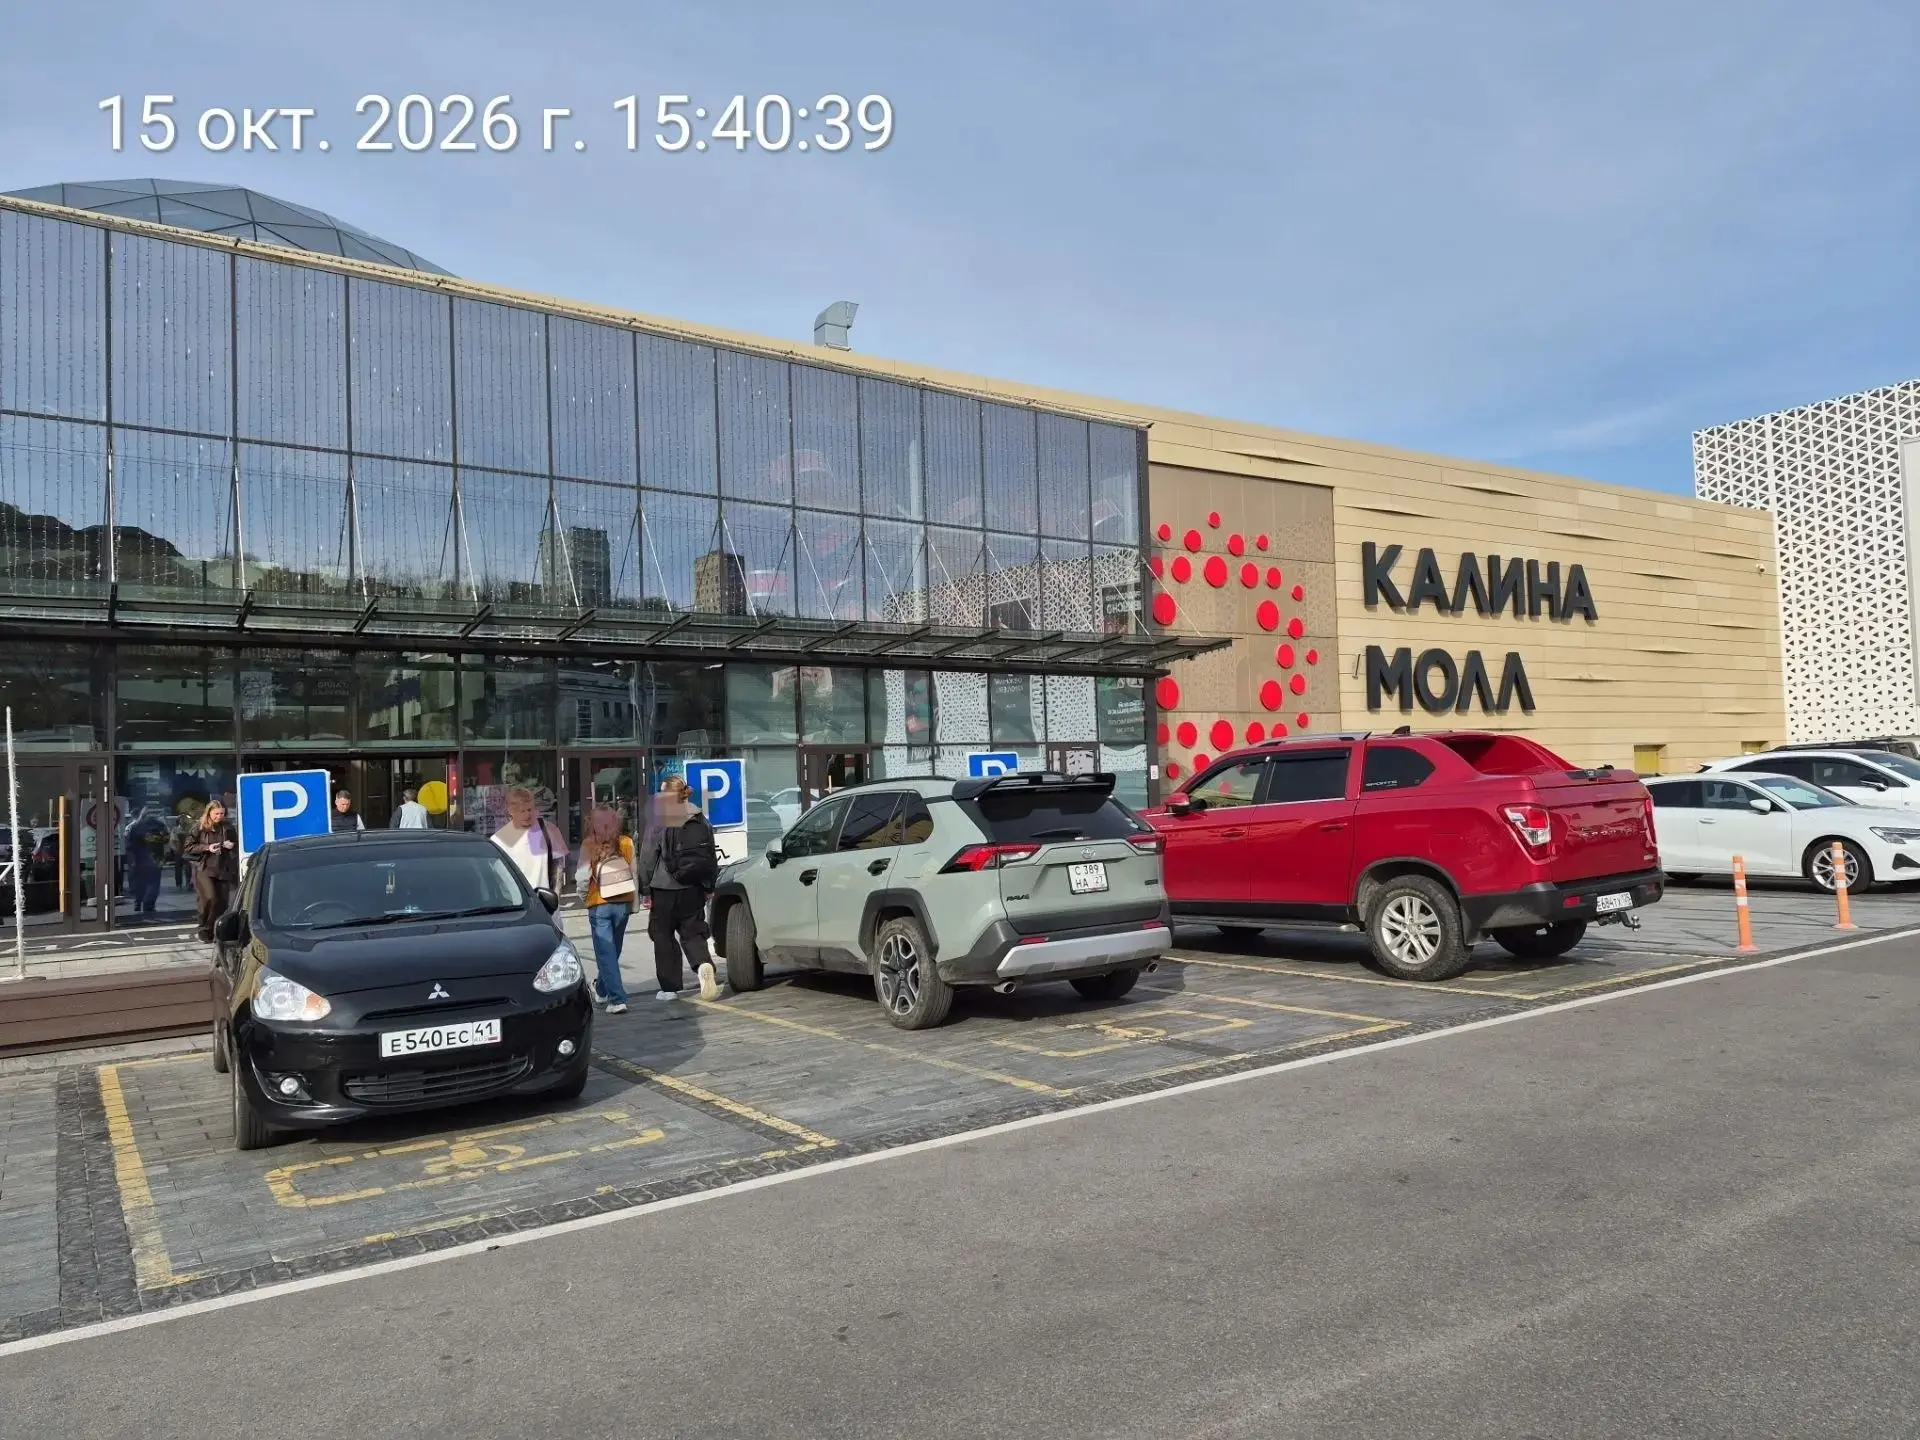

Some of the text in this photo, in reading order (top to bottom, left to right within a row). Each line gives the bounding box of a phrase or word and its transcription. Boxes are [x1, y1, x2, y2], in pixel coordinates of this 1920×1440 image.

[1361, 541, 1599, 621] КАЛИНА
[1366, 645, 1536, 713] МОЛЛ
[261, 781, 309, 843] P
[699, 768, 731, 820] P
[1083, 864, 1100, 875] 389
[474, 1021, 493, 1037] 41
